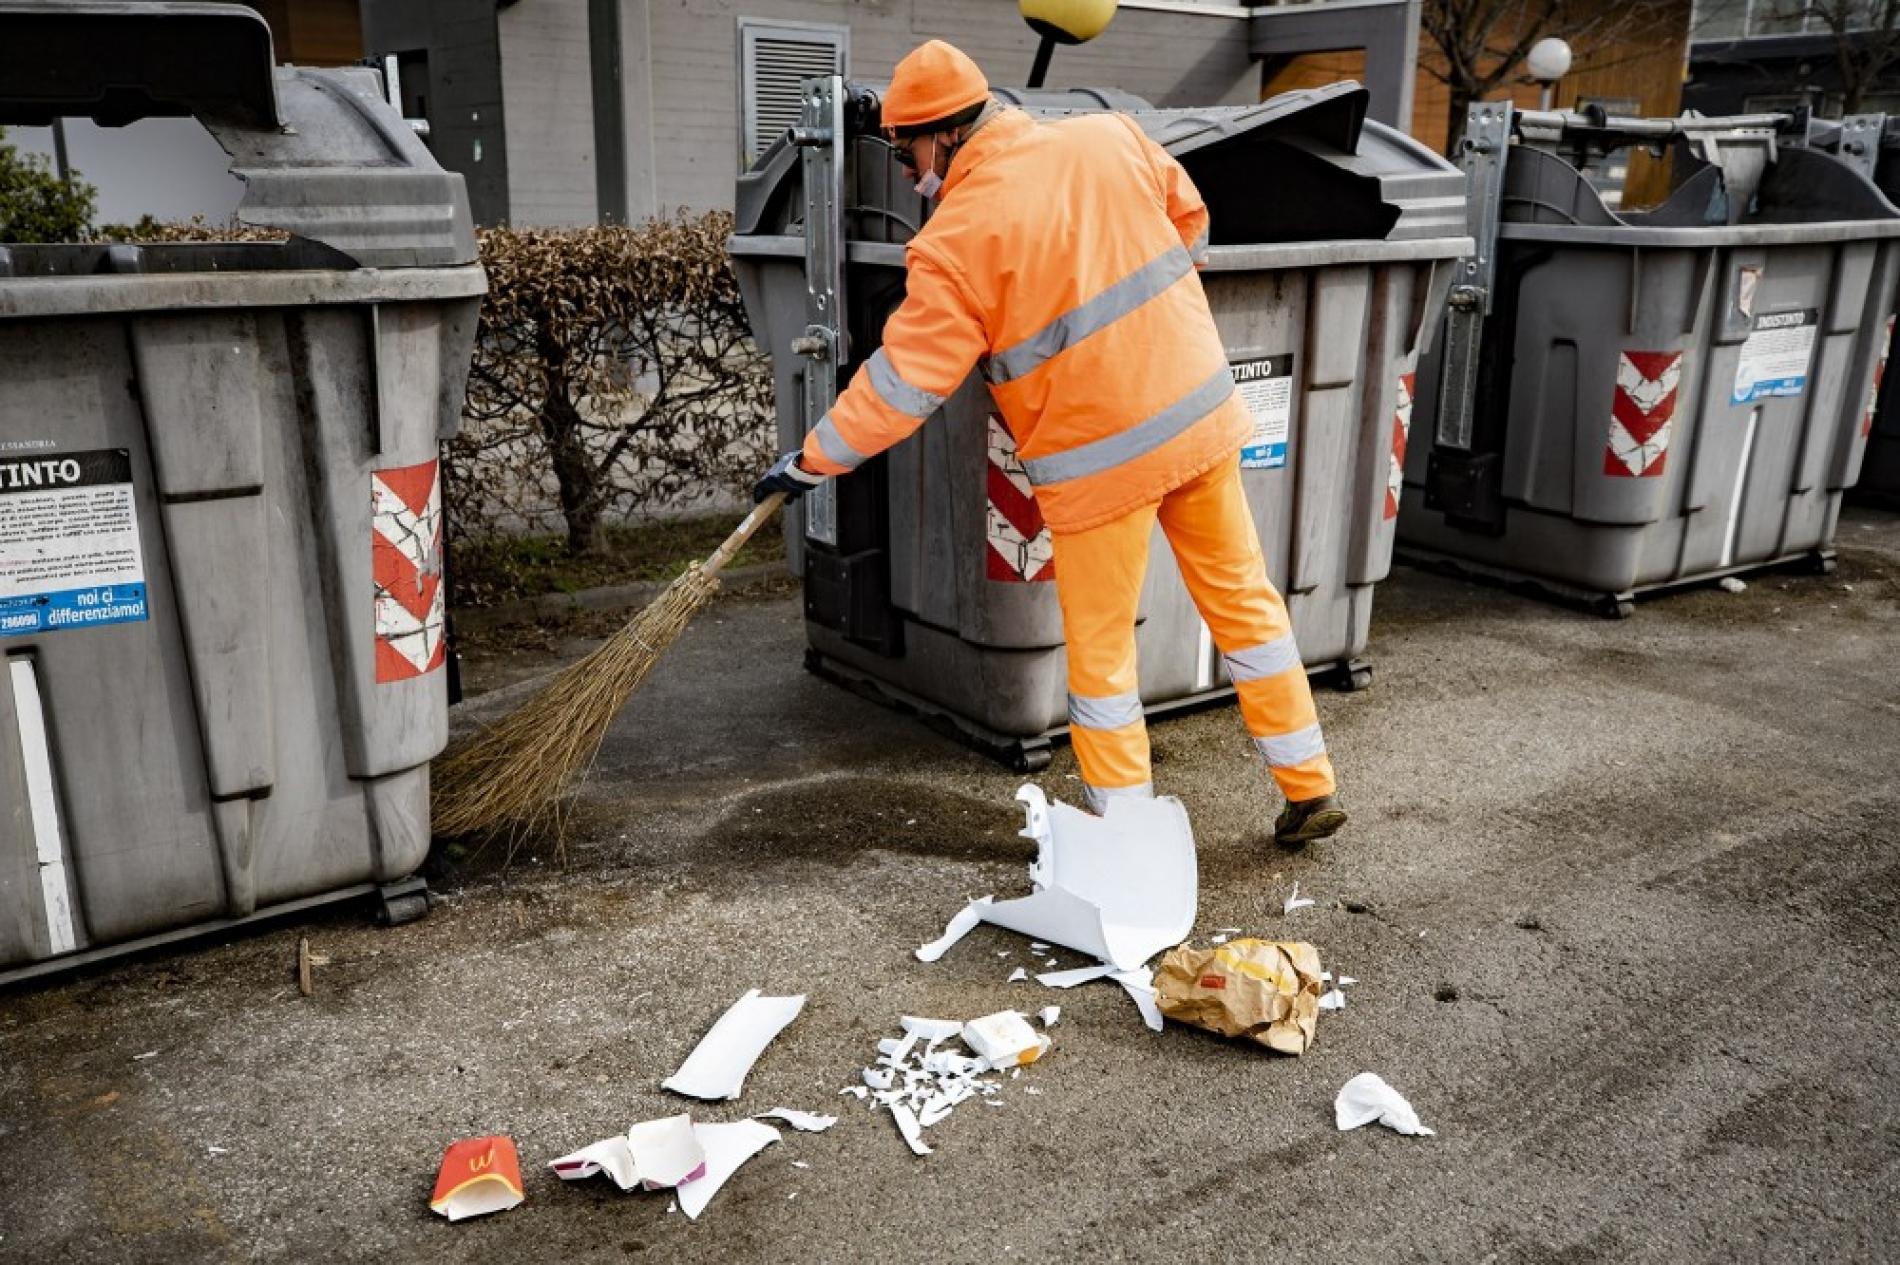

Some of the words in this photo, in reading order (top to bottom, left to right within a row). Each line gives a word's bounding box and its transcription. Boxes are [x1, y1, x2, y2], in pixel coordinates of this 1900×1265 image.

[77, 588, 98, 606] noi
[102, 587, 114, 604] ci
[48, 600, 145, 625] differenziamo!
